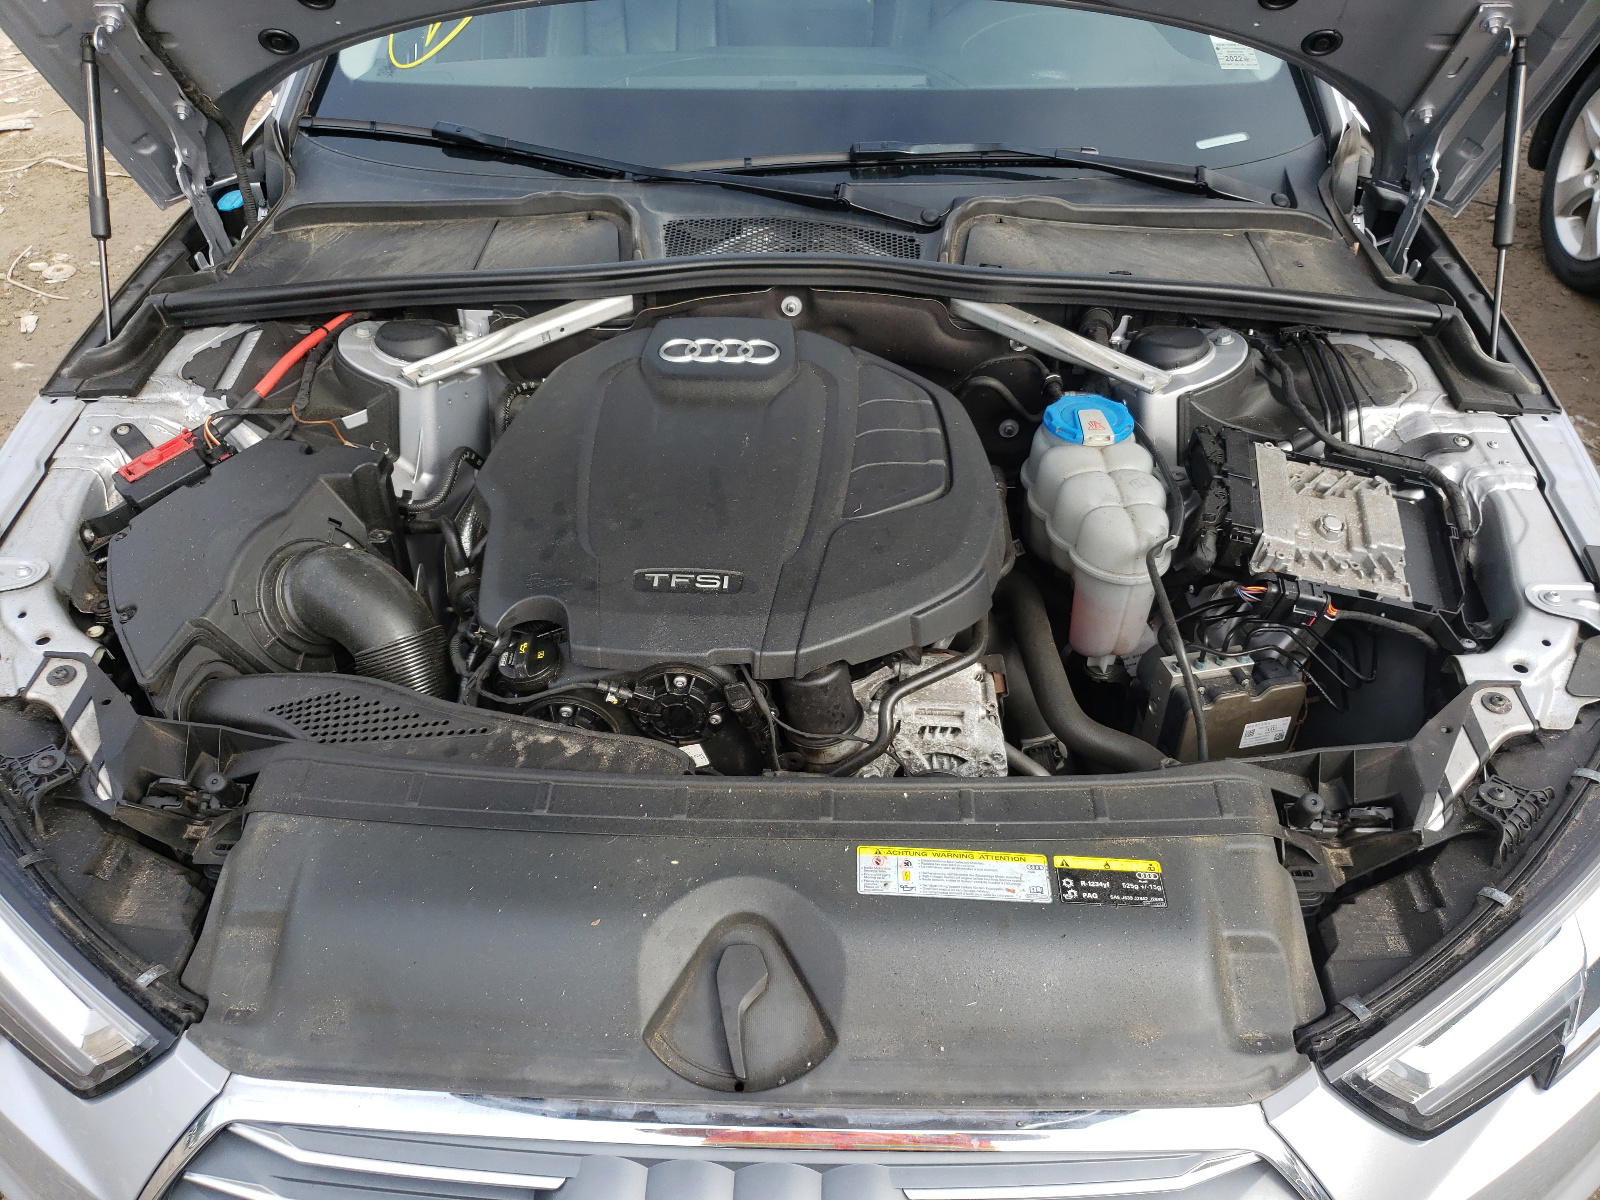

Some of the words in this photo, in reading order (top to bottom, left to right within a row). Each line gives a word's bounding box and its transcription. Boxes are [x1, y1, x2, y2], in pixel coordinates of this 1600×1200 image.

[645, 573, 729, 589] TFSI
[932, 852, 974, 860] WARNING
[979, 854, 1026, 862] ATTENTION
[1080, 880, 1110, 888] R-1234yf
